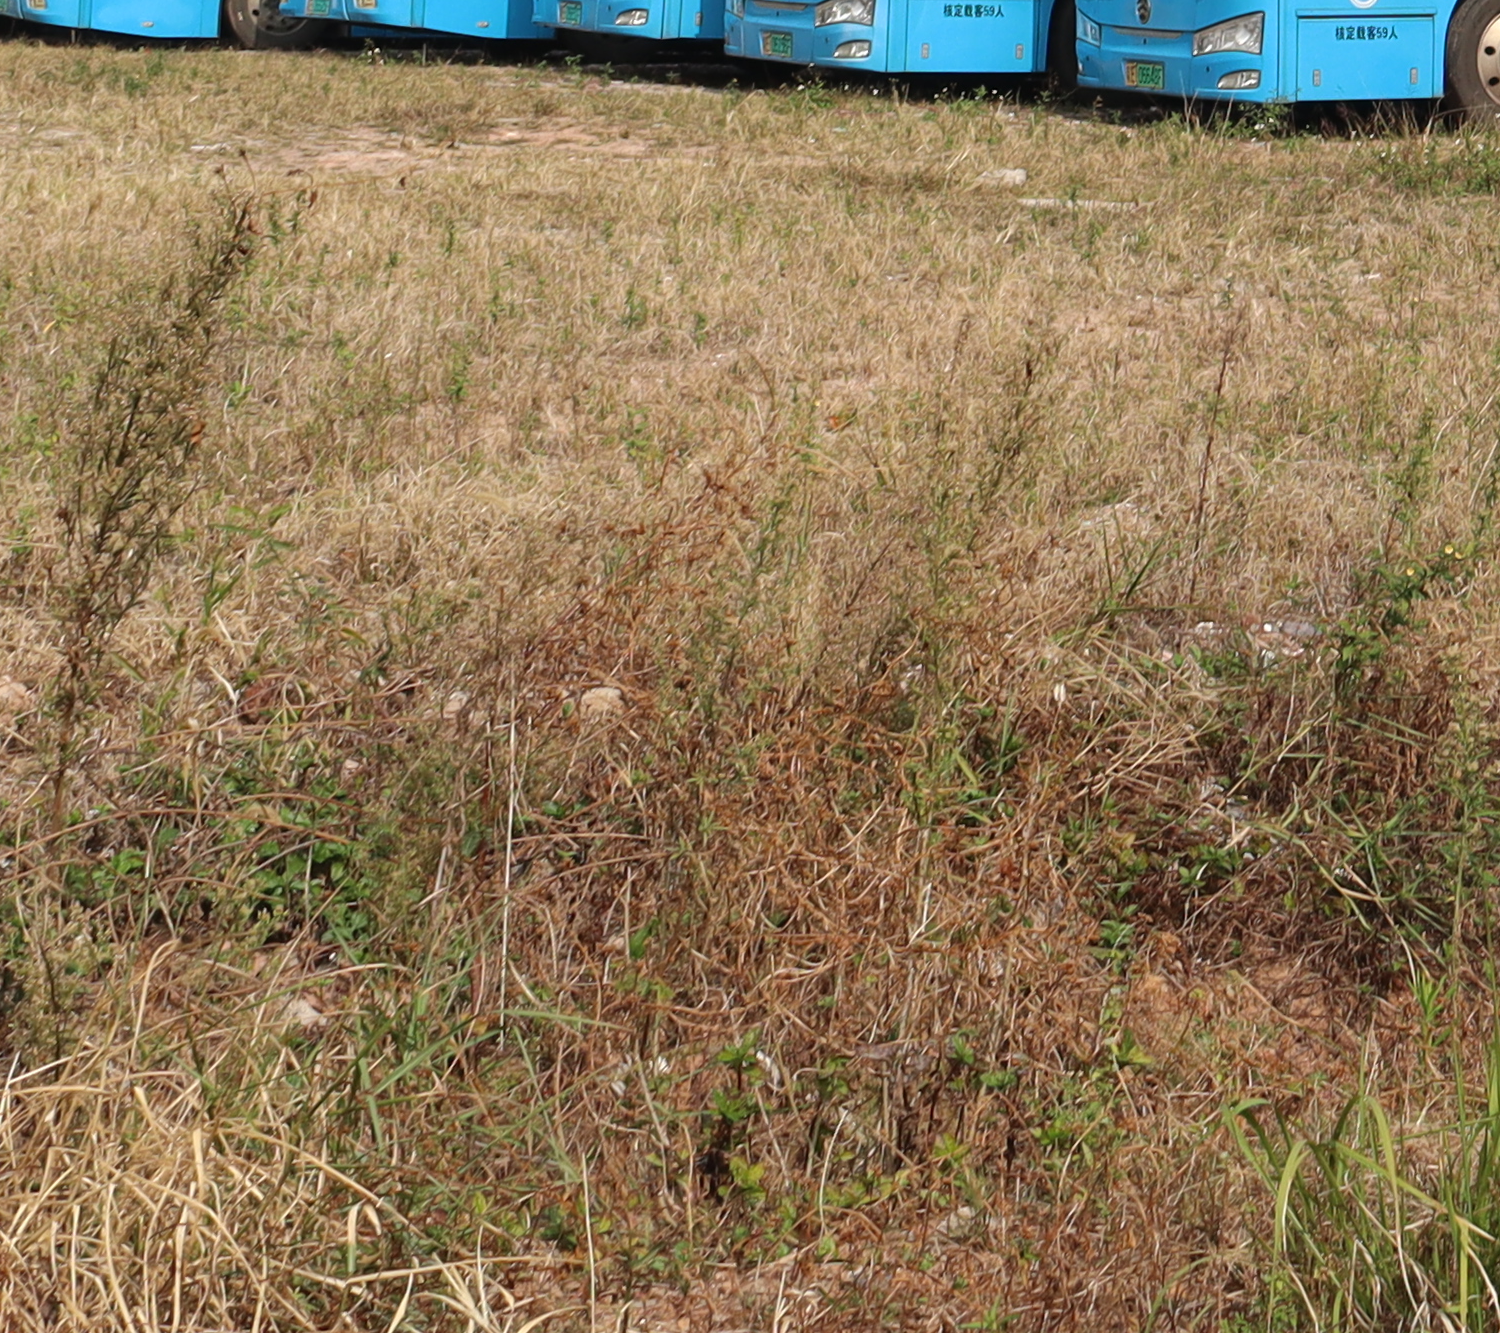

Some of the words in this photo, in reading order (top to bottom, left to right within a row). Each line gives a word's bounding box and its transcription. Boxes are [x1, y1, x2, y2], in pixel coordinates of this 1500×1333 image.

[1335, 25, 1399, 41] 核定载客59人
